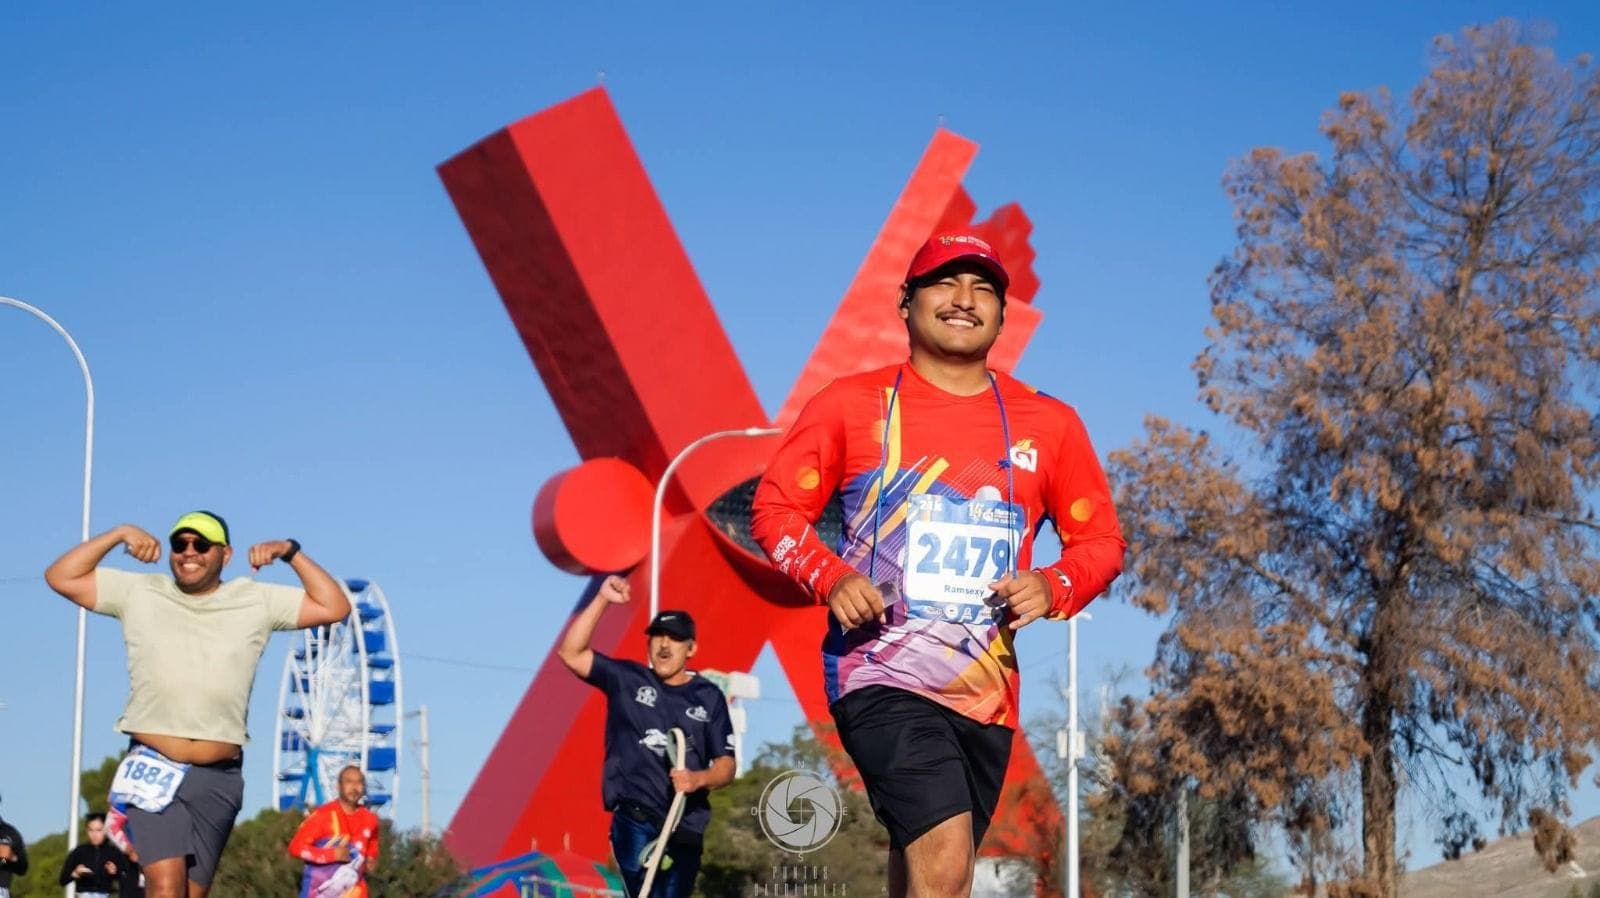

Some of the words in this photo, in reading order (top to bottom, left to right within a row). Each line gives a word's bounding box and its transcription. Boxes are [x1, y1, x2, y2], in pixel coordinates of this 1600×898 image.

[916, 532, 1011, 580] 2479
[944, 584, 985, 597] Ramsexy
[124, 759, 175, 797] 1884
